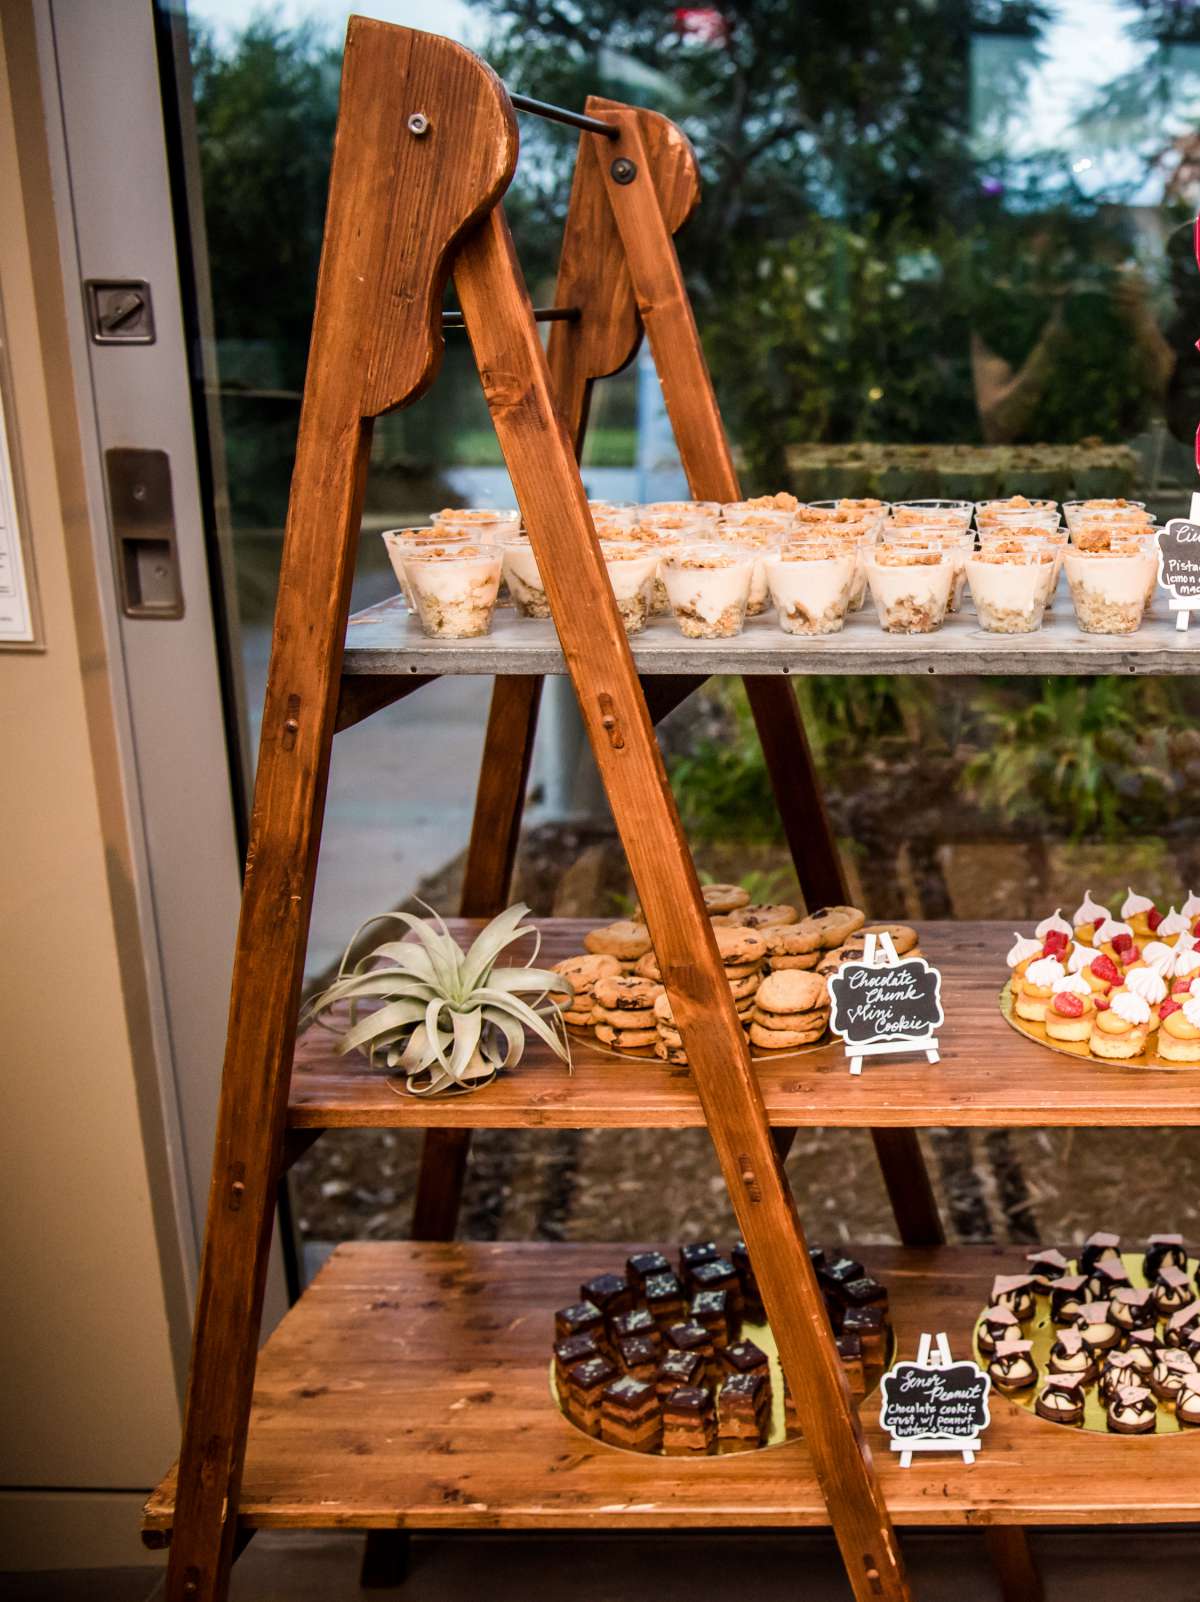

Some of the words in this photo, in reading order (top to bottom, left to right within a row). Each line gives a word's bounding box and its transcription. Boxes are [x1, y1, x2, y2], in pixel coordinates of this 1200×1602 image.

[1166, 573, 1196, 585] lemon
[848, 969, 917, 989] Chocolate
[865, 984, 925, 1004] Chunk
[847, 1003, 893, 1023] Mini
[874, 1015, 930, 1034] Cookie
[923, 1384, 982, 1403] Peanut
[939, 1402, 977, 1415] cookie
[886, 1414, 916, 1426] crust
[920, 1414, 935, 1427] w/
[936, 1413, 974, 1427] peanut
[897, 1422, 927, 1435] butter
